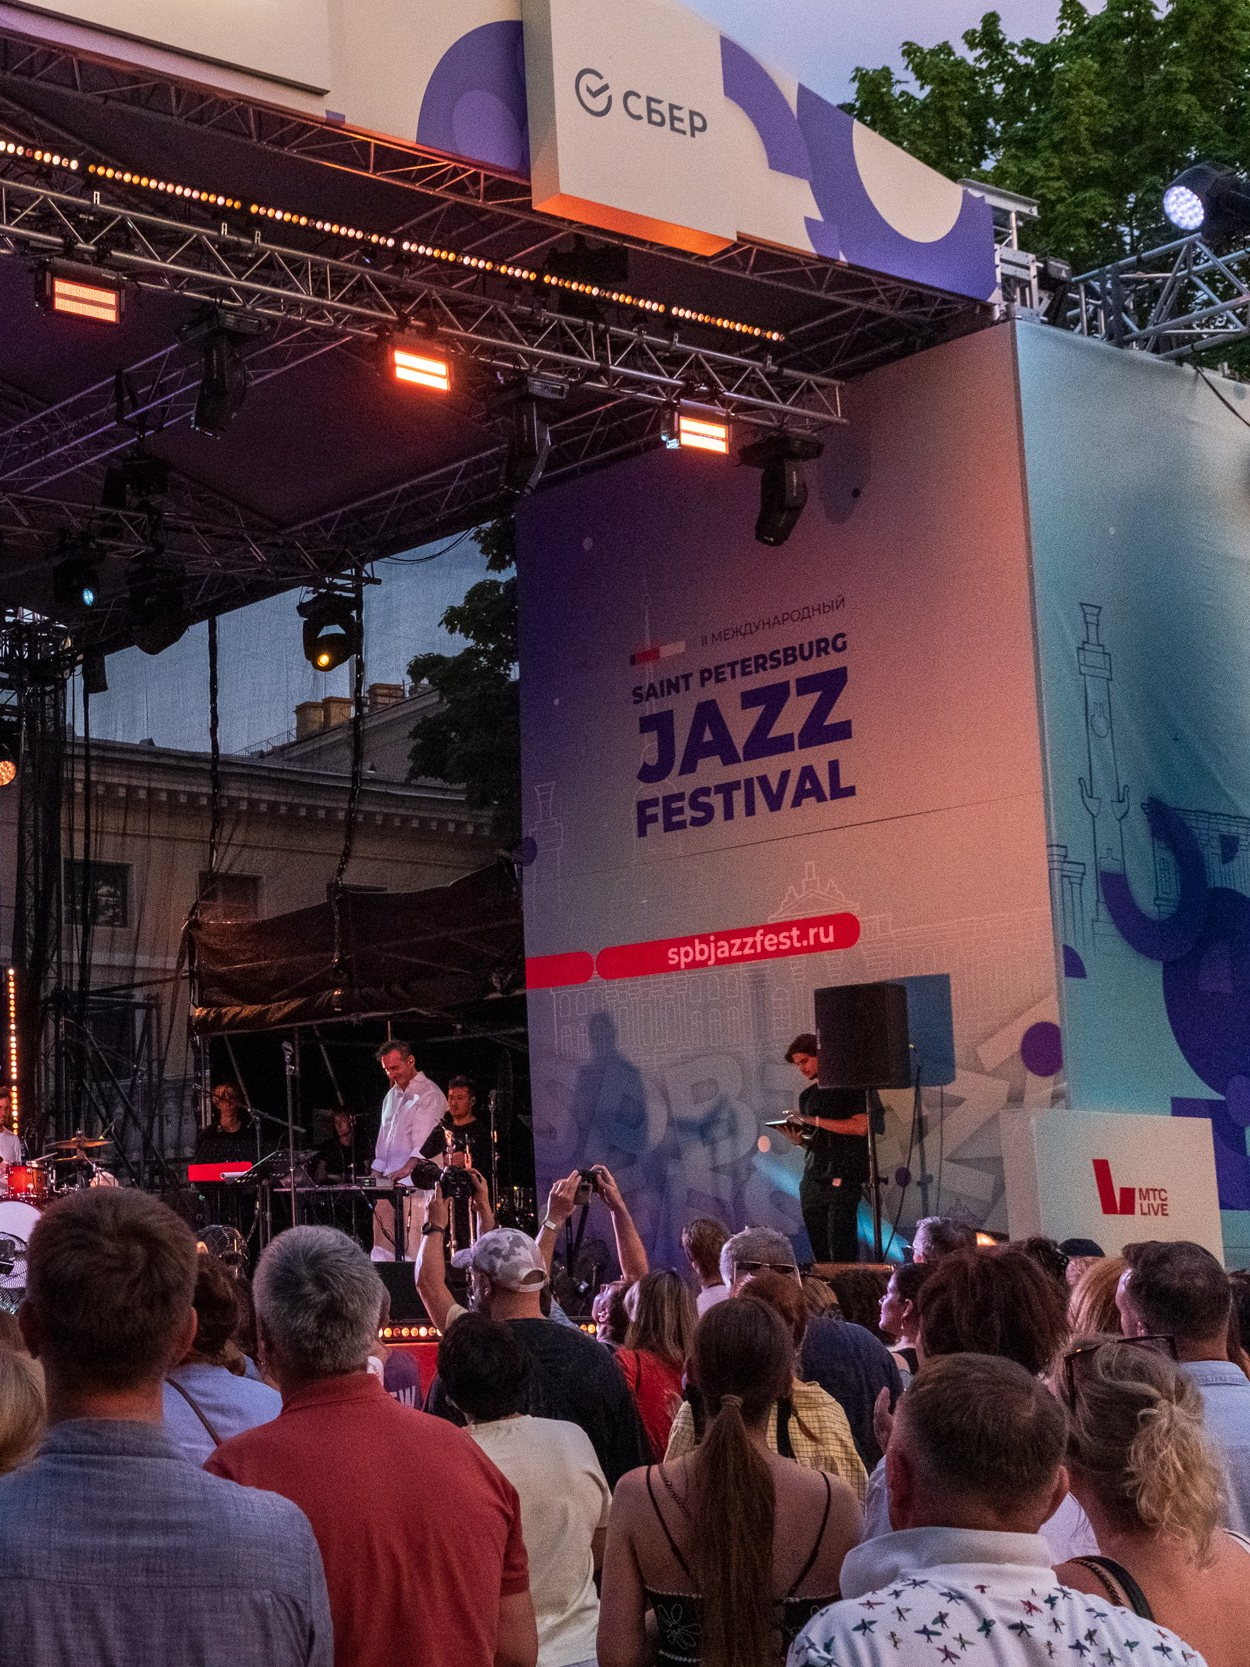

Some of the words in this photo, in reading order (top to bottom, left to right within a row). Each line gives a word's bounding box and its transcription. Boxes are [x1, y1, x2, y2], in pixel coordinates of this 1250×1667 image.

[623, 90, 707, 138] СБЕР
[711, 594, 846, 645] МЕЖДУНАРОДНЫЙ
[632, 672, 693, 704] SAINT
[700, 632, 848, 687] PETERSBURG
[636, 666, 853, 784] JAZZ
[636, 759, 856, 838] FESTIVAL
[667, 925, 834, 969] spbjazzfest.ru
[1140, 1203, 1169, 1217] LIVE
